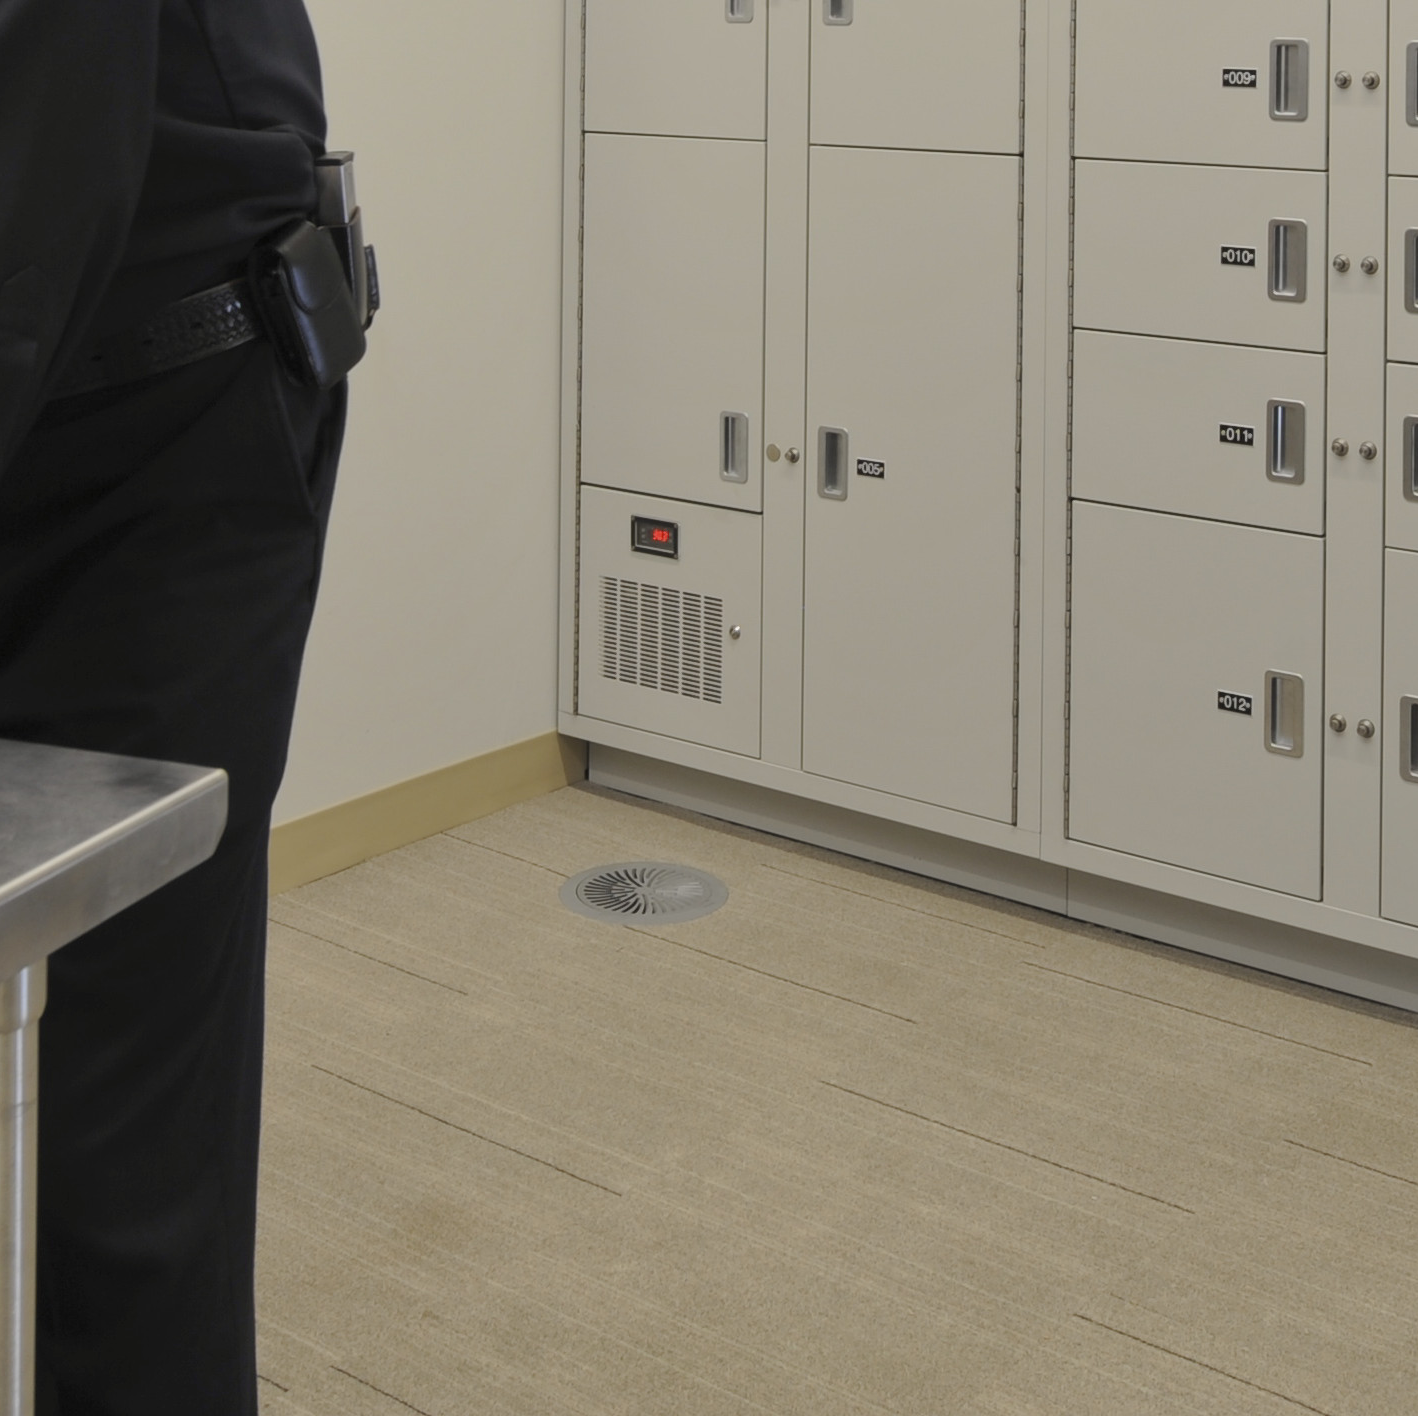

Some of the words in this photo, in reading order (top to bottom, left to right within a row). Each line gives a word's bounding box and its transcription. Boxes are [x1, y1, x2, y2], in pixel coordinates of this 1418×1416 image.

[1228, 71, 1251, 85] 009
[1226, 249, 1250, 264] 010
[1226, 427, 1249, 442] 011
[861, 462, 879, 475] 005
[1224, 695, 1246, 711] 012
